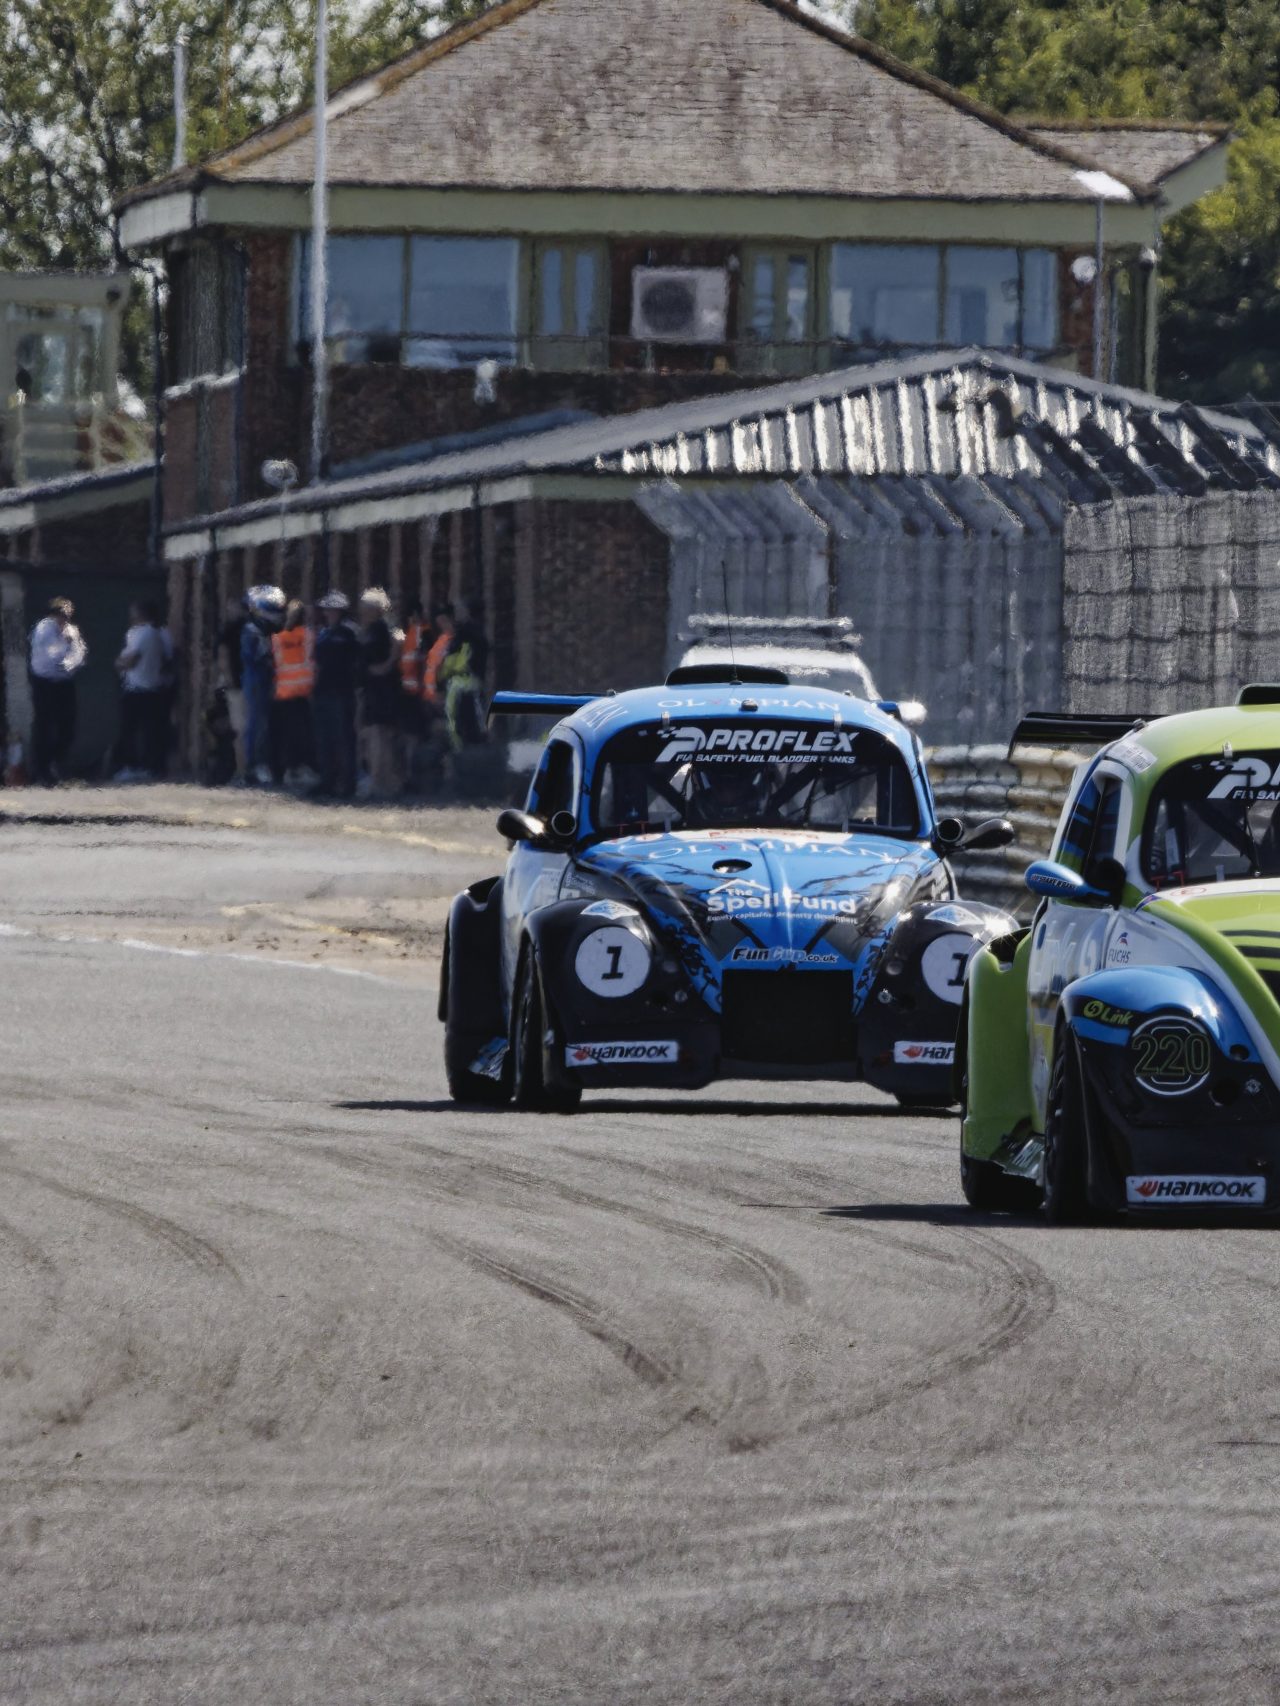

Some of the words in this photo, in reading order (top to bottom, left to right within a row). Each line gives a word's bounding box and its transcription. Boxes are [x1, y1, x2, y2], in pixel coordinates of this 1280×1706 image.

[706, 729, 860, 752] PROFLEX
[675, 753, 692, 762] FIA
[695, 754, 738, 763] SAFETY
[738, 754, 765, 763] FUEL
[768, 754, 818, 763] BLADDER
[726, 888, 752, 896] The
[707, 893, 779, 912] Spell
[787, 893, 857, 914] Fund
[601, 946, 623, 980] 1
[1108, 949, 1130, 963] FUCHS
[947, 953, 969, 986] 1
[1104, 1008, 1134, 1025] Link
[1132, 1033, 1211, 1076] 220
